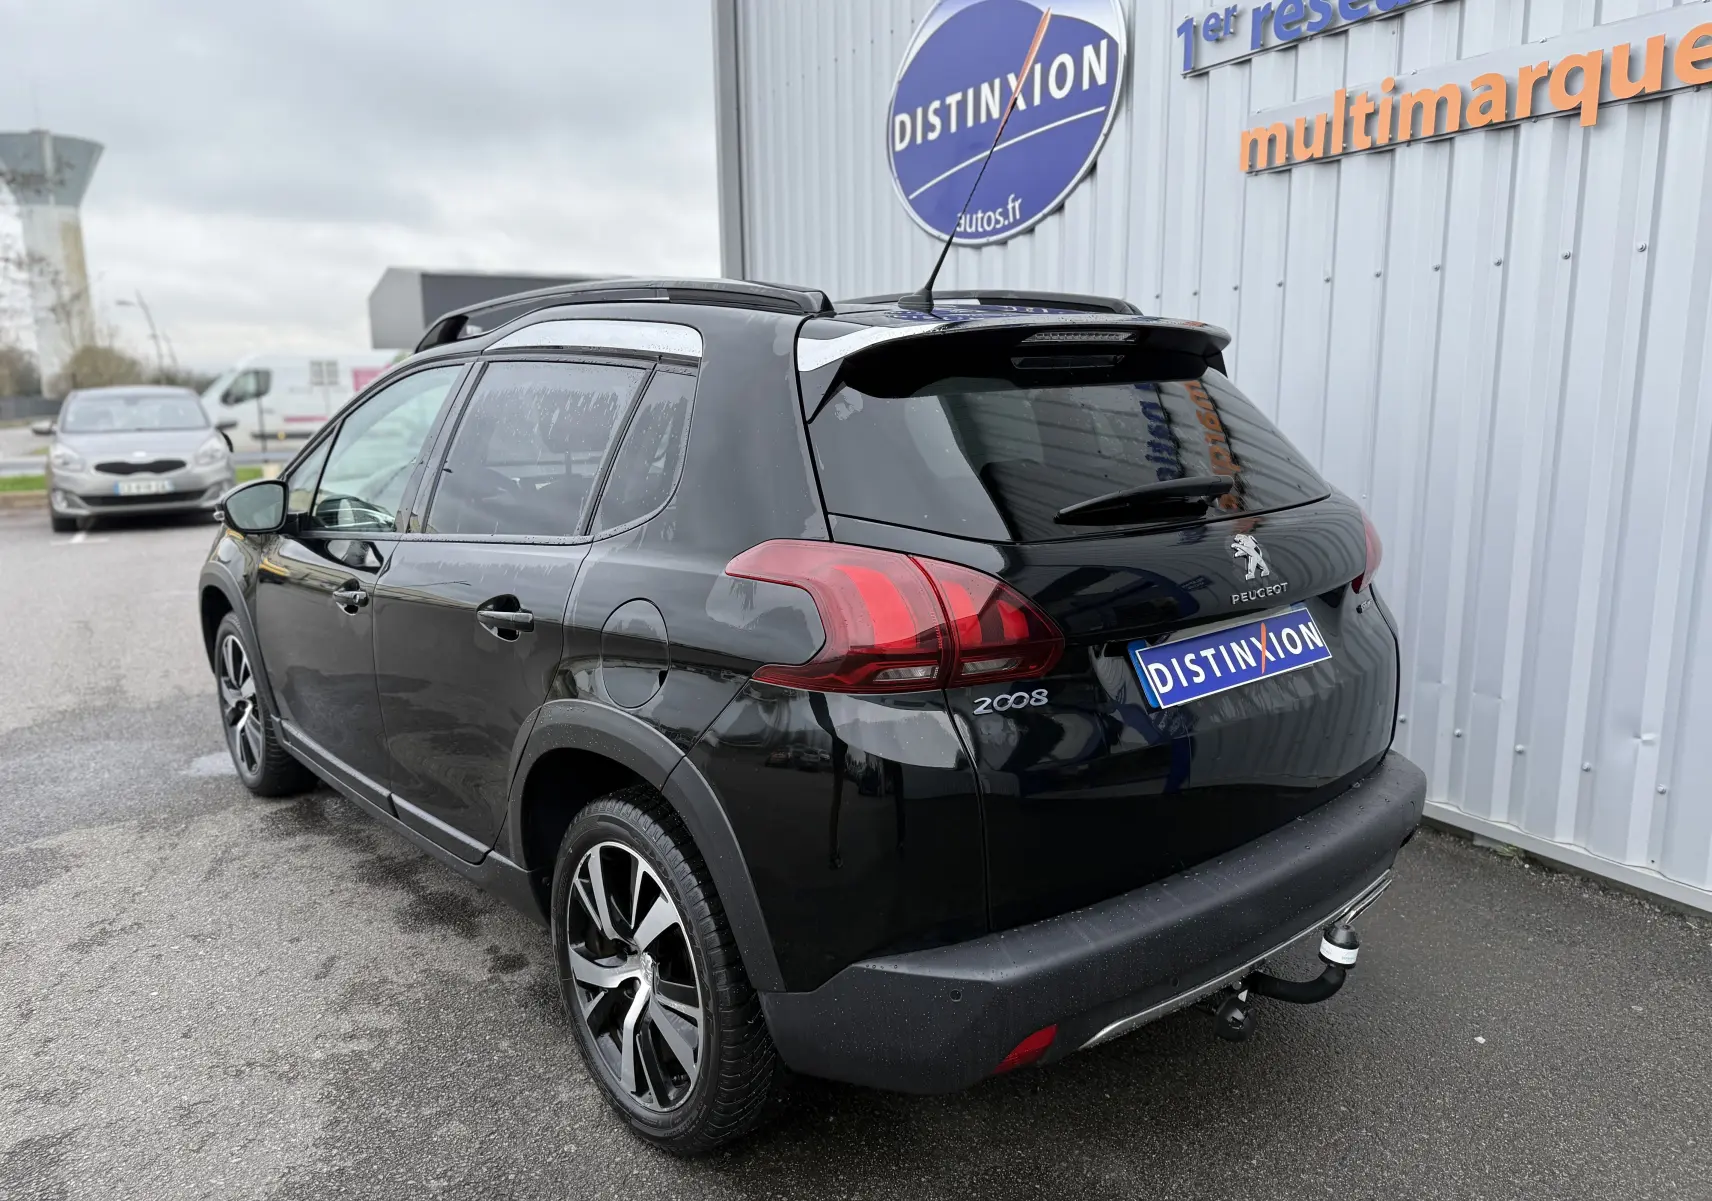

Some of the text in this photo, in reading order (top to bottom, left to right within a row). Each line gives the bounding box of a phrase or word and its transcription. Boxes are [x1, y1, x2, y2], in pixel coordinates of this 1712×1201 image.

[1177, 4, 1237, 71] 1er
[894, 39, 1108, 151] DISTINXION
[1240, 22, 1712, 172] multimarque
[956, 194, 1022, 232] autos.fr
[1232, 582, 1288, 605] PEUGEOT
[1148, 622, 1323, 694] DISTINXION
[973, 688, 1048, 715] 2008
